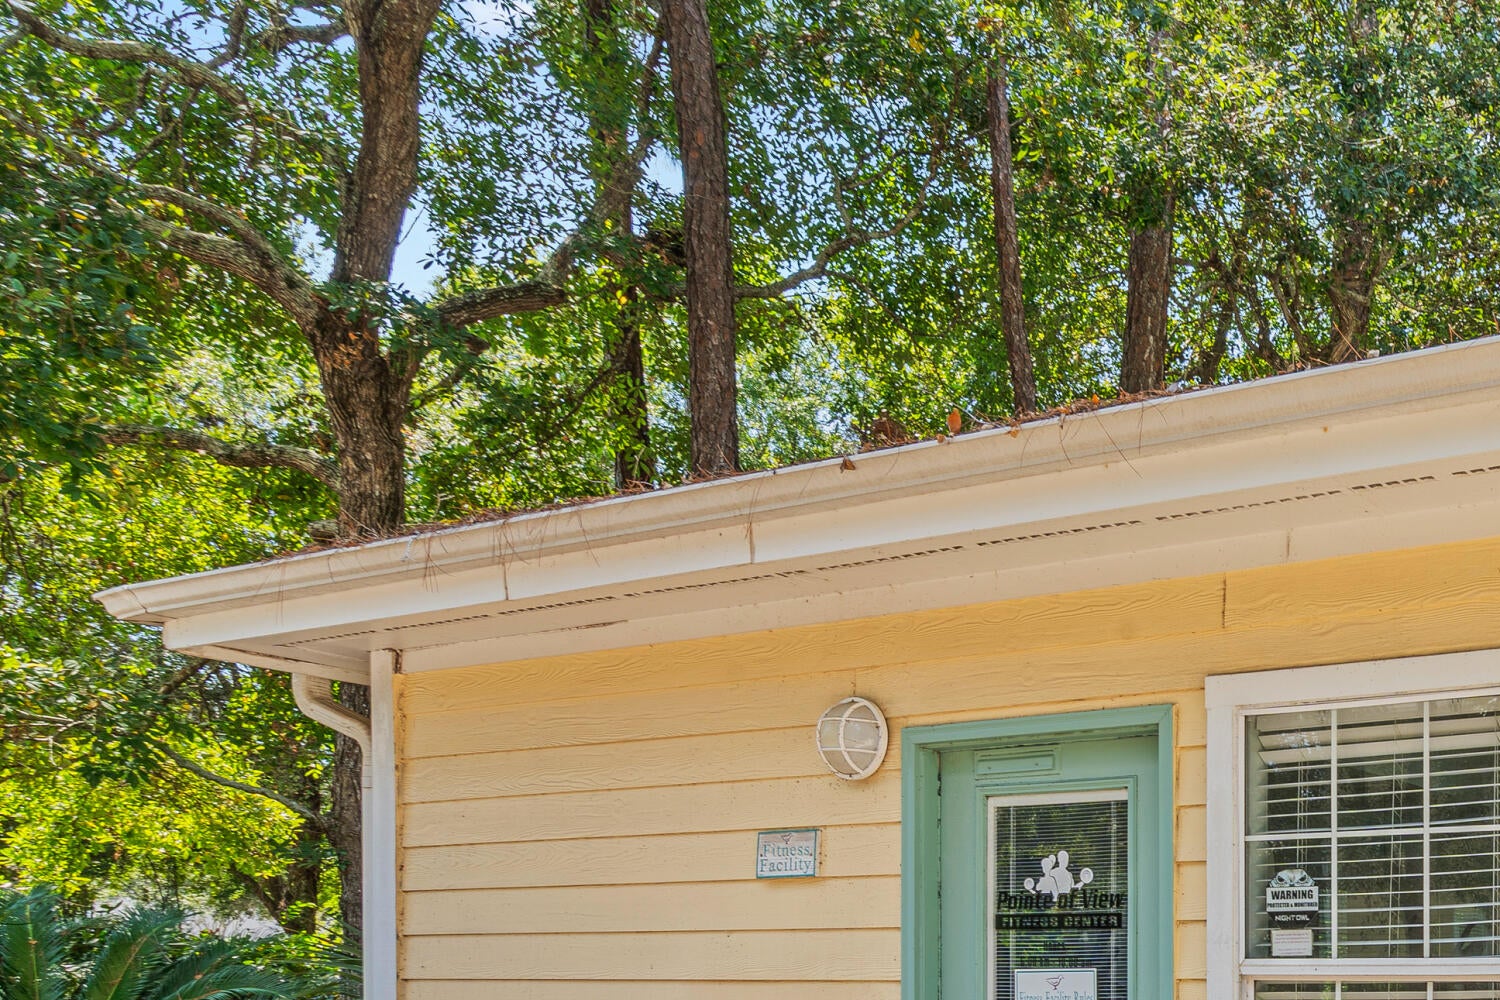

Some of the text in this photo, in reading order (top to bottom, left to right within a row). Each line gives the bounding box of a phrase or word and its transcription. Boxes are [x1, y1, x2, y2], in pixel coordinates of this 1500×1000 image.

[760, 844, 812, 873] Fitness Facility
[998, 888, 1121, 909] Pointe of View
[1271, 890, 1313, 900] WARNING
